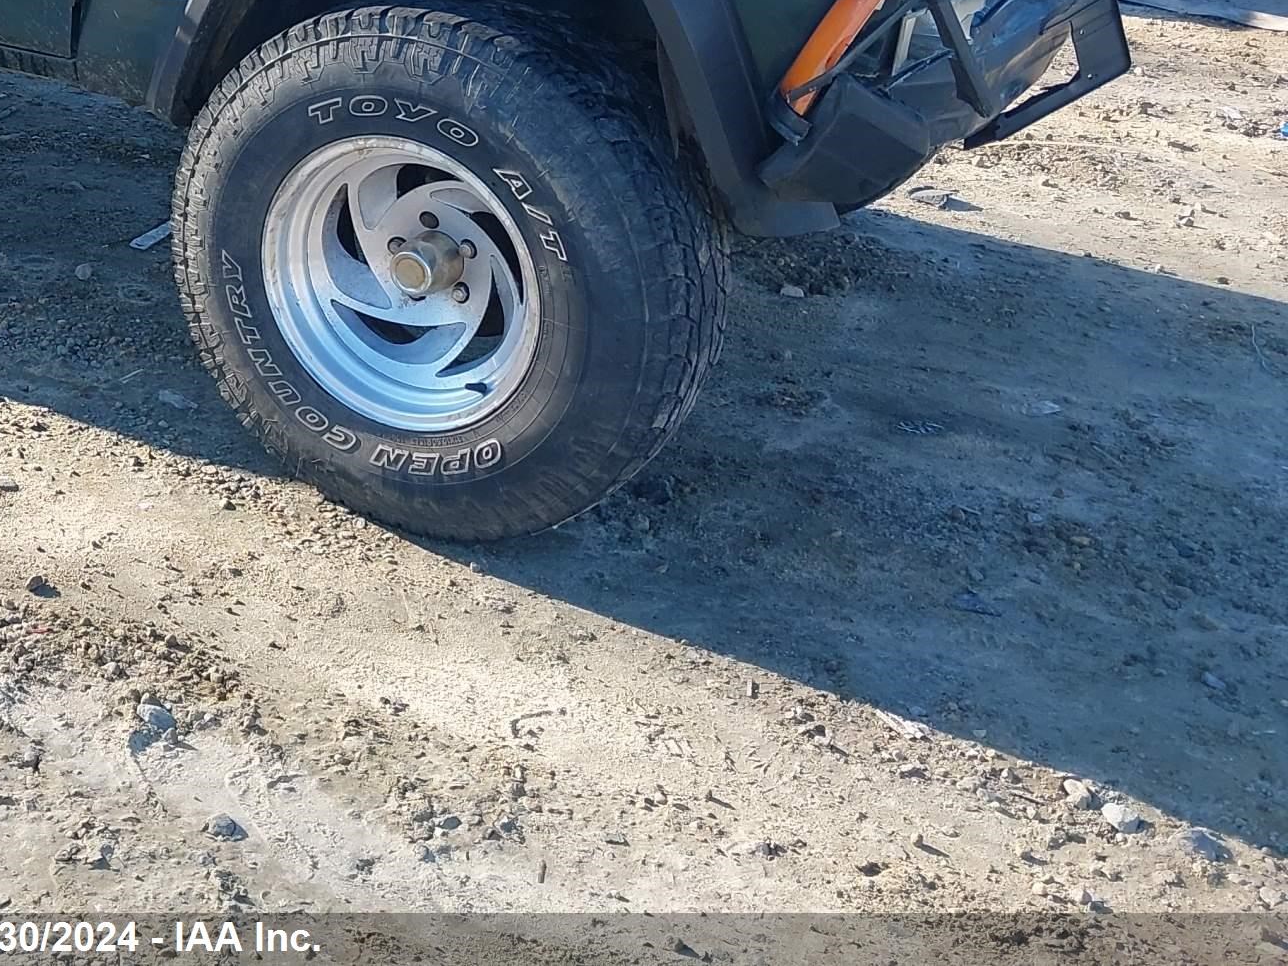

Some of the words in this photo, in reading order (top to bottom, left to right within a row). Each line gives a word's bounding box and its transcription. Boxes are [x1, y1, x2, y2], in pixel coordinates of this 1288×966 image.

[307, 94, 480, 148] TOYO
[492, 167, 568, 262] A/T
[221, 249, 360, 452] COUNTRY
[368, 437, 503, 476] OPEN
